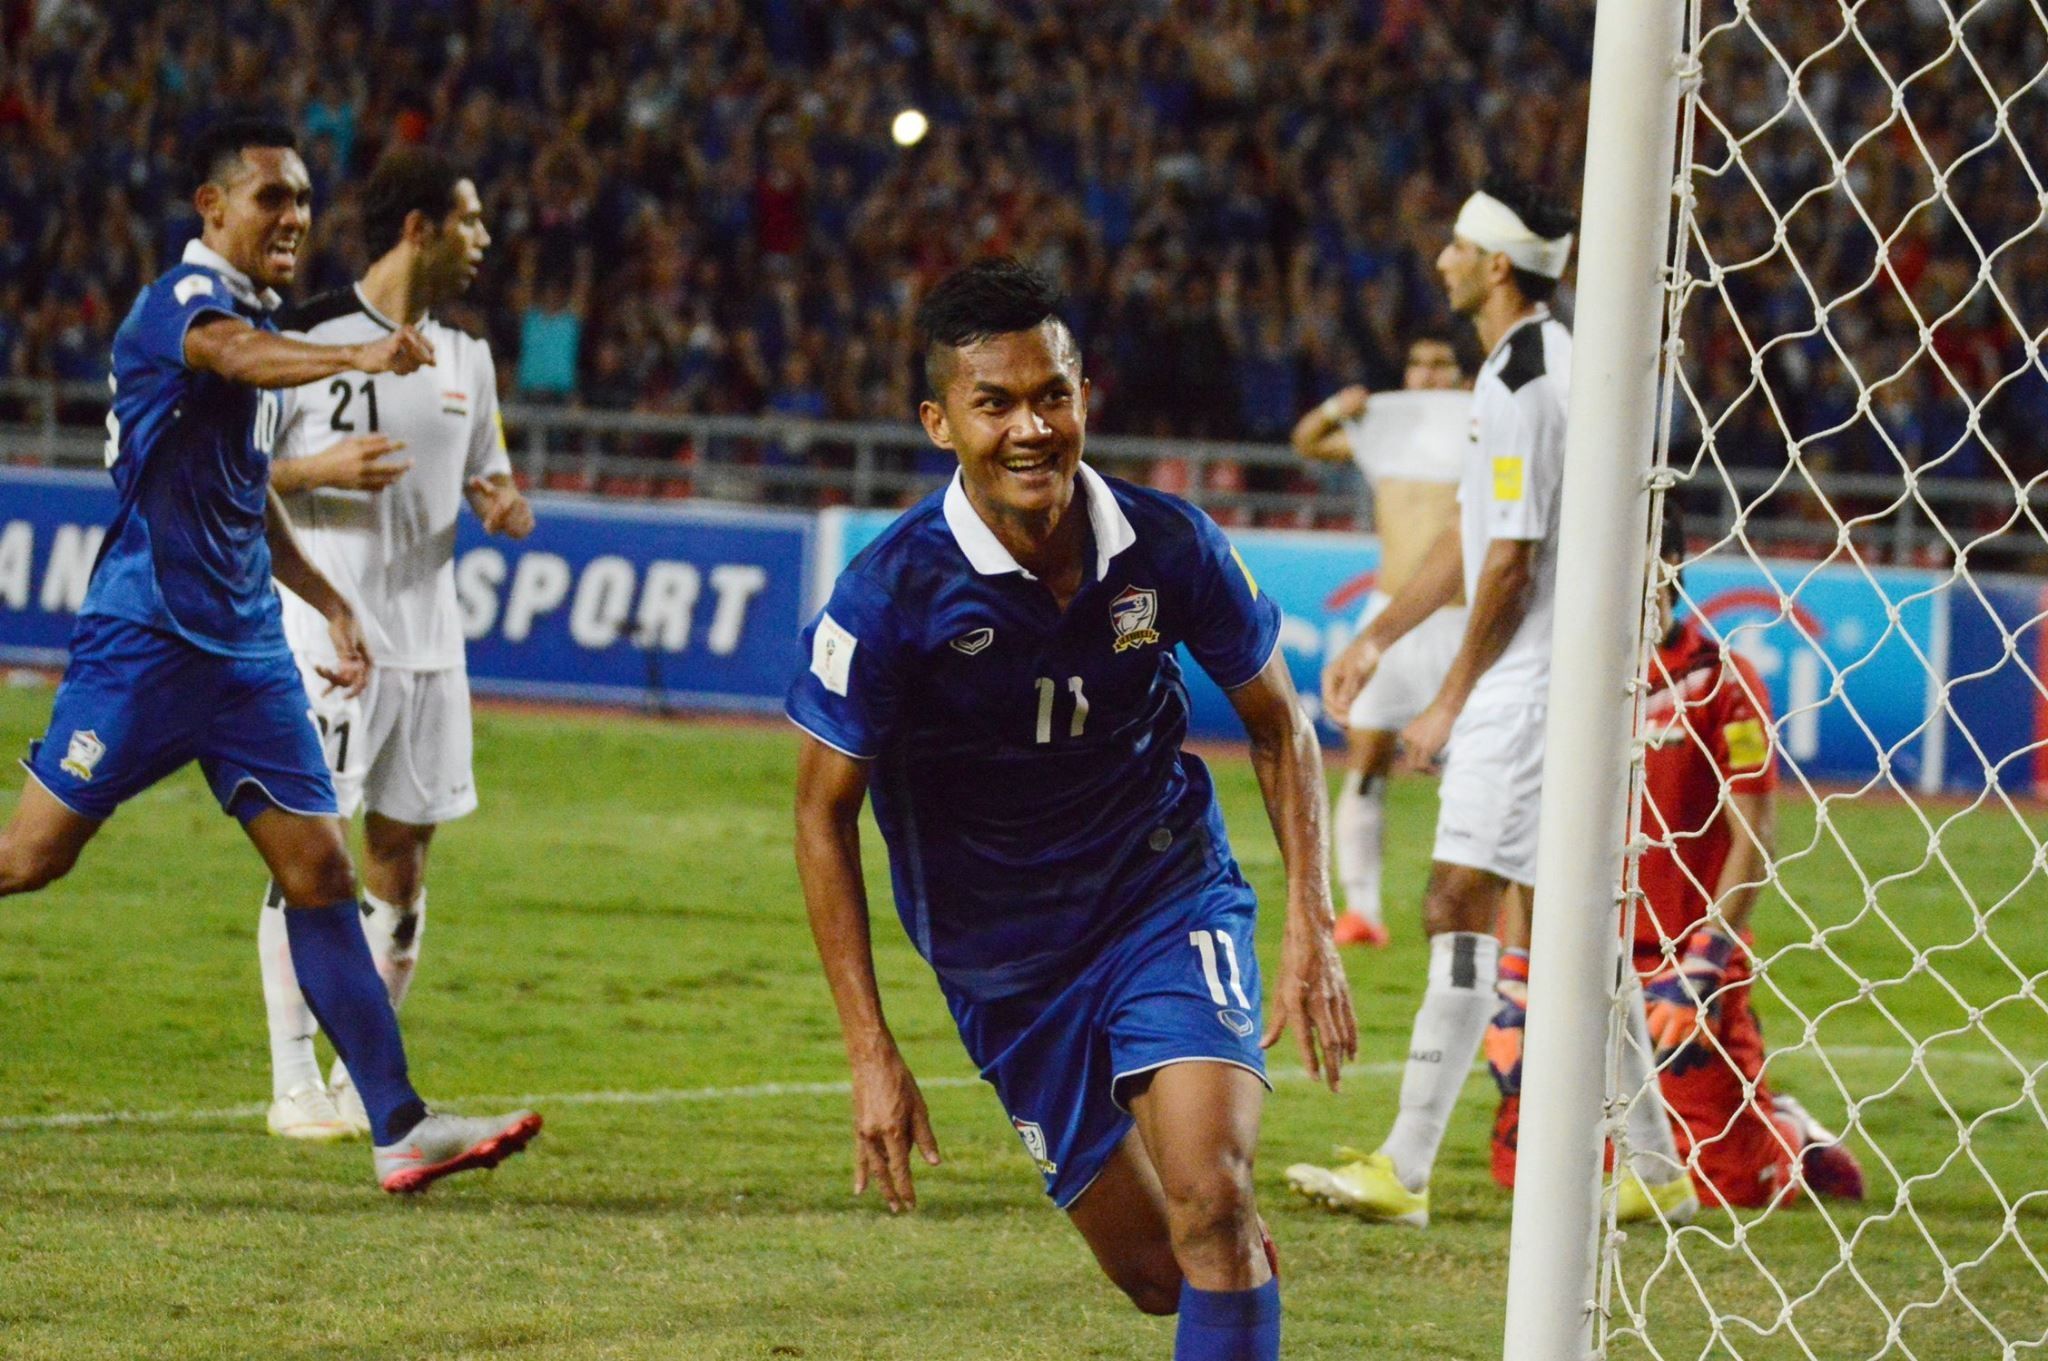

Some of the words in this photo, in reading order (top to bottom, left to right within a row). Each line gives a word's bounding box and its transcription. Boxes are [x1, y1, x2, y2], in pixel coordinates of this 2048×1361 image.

[254, 388, 278, 453] 10
[330, 379, 378, 432] 21
[456, 547, 767, 656] SPORT
[1034, 676, 1089, 743] 11
[1189, 929, 1251, 1010] 11
